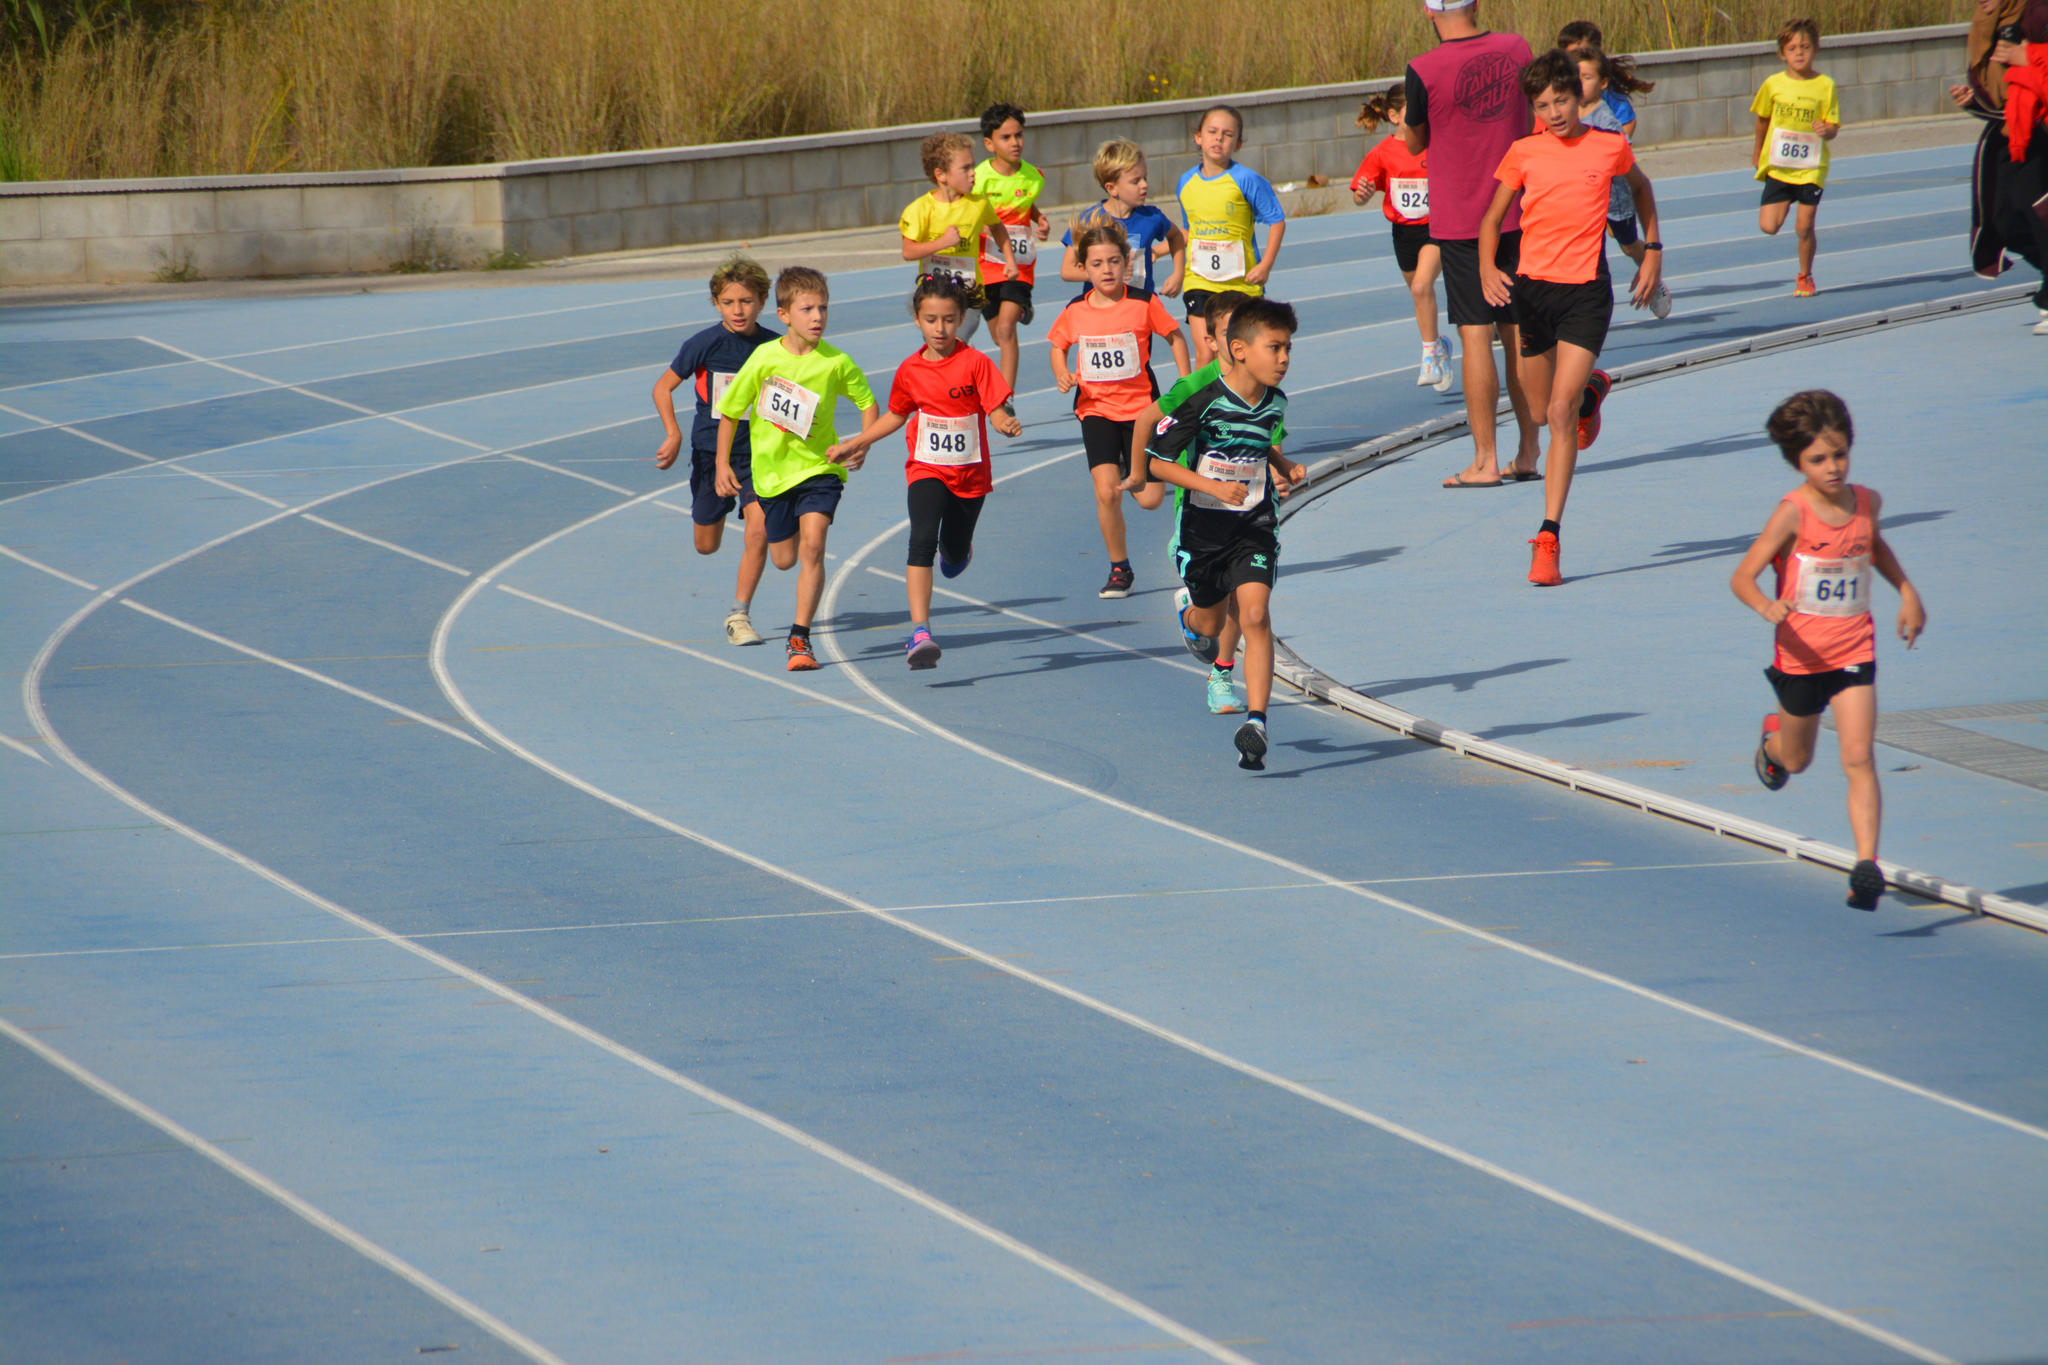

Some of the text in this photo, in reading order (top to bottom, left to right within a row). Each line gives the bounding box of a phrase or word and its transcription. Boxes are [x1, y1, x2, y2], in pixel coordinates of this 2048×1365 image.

[1781, 142, 1809, 159] 863
[1211, 254, 1221, 271] 8
[1091, 350, 1126, 369] 488
[771, 392, 799, 421] 541
[930, 432, 966, 453] 948
[1816, 577, 1857, 601] 641
